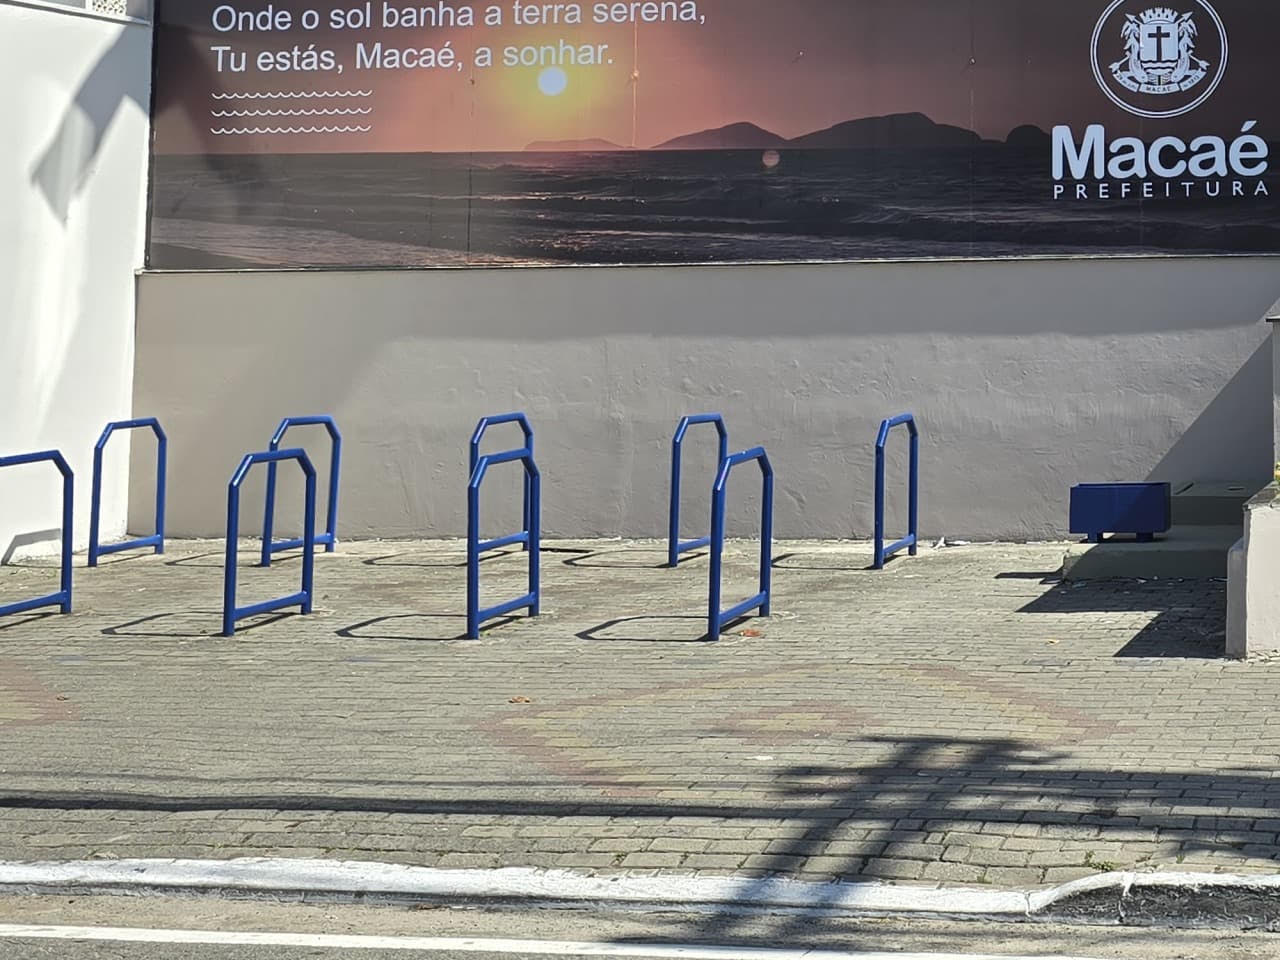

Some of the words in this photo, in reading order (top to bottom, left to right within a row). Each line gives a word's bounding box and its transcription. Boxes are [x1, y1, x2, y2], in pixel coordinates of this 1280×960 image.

[213, 5, 291, 31] Onde
[302, 10, 319, 29] o
[330, 2, 370, 28] sol
[383, 1, 473, 27] banha
[485, 6, 501, 25] a
[513, 0, 581, 24] terra
[593, 1, 705, 24] serena,
[211, 46, 246, 72] Tu
[257, 44, 342, 73] estás,
[356, 41, 462, 71] Macaé,
[475, 47, 491, 66] a
[503, 39, 612, 65] sonhar.
[1051, 120, 1268, 180] Macaé
[1053, 180, 1268, 199] PREFEITURA
